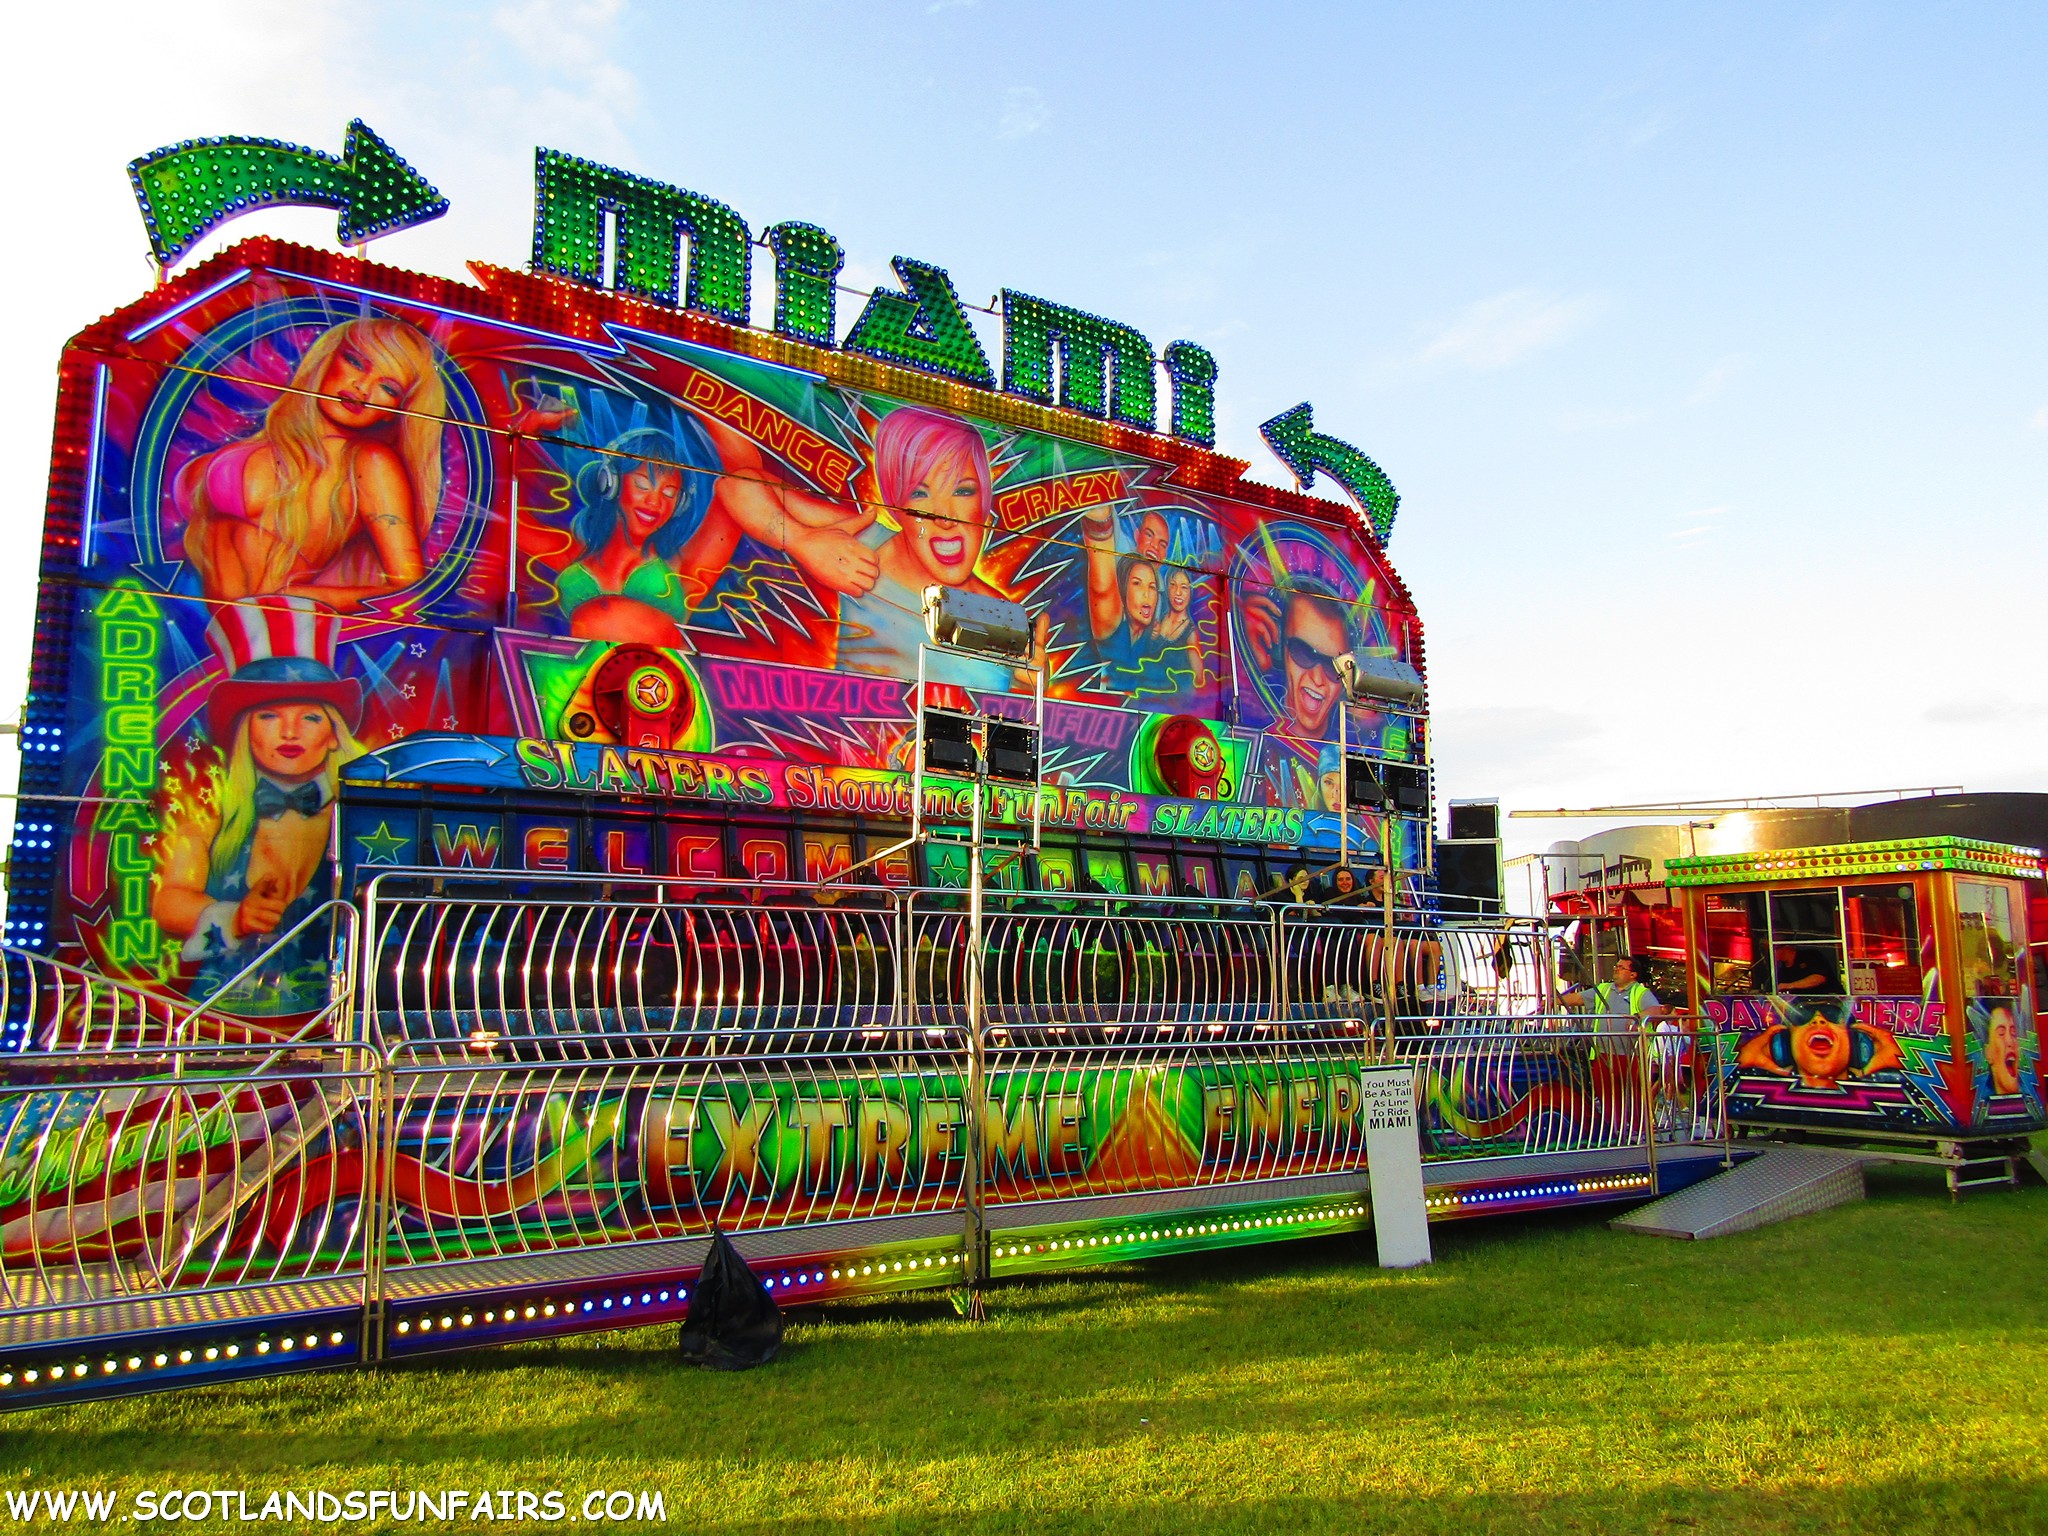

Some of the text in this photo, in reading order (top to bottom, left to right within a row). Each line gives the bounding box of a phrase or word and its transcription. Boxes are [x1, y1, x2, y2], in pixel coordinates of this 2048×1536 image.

[683, 370, 856, 494] DANCE
[998, 470, 1121, 532] CRAZY
[710, 664, 900, 712] MUZIC
[96, 578, 161, 962] ADRENALIN
[515, 738, 775, 804] SLATERS
[1151, 802, 1306, 844] SLATERS
[432, 823, 910, 884] WELCOME
[1706, 999, 1946, 1036] PAY HERE
[1364, 1087, 1412, 1099] Be As Tall
[1366, 1078, 1411, 1089] You Must
[1373, 1098, 1409, 1108] As Line
[1369, 1115, 1412, 1130] MIAMI
[1372, 1107, 1409, 1118] To Ride
[641, 1092, 1089, 1211] EXTREME
